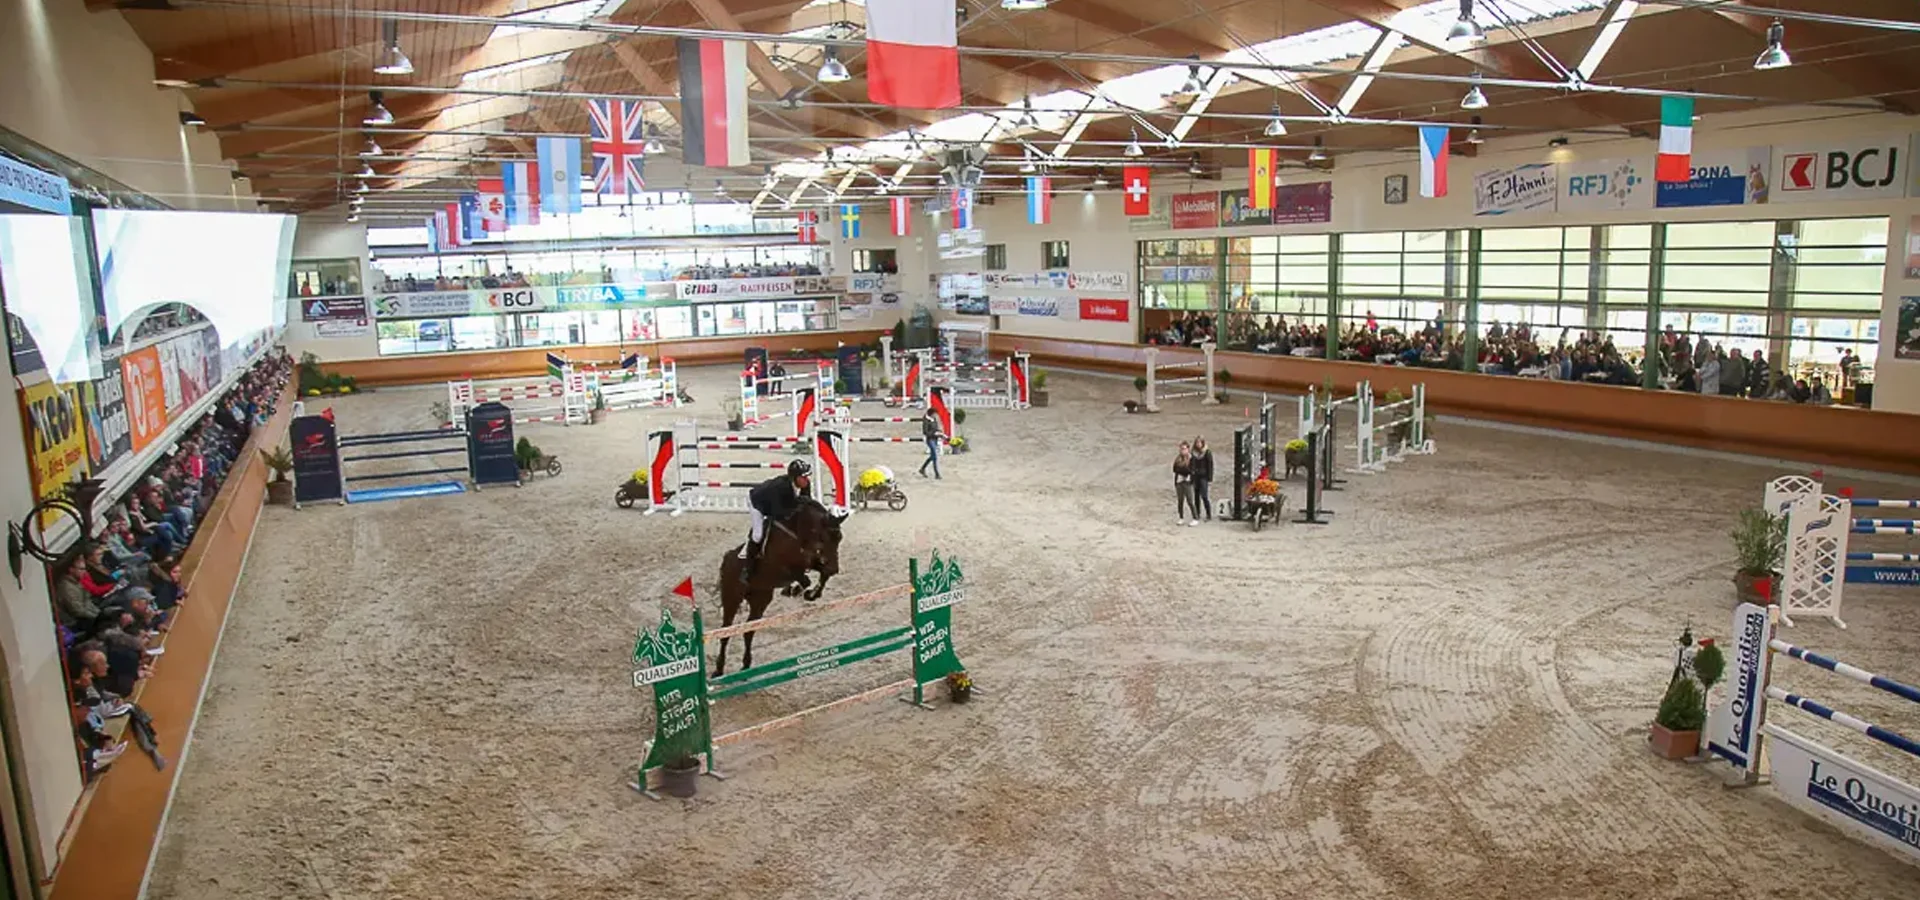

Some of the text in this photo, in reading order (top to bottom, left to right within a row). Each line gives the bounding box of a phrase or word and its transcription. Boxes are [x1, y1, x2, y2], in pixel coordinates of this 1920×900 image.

[1825, 147, 1898, 189] BCJ
[1569, 175, 1608, 197] RFJ
[562, 286, 618, 302] TRYBA
[740, 283, 791, 292] RAIFFEISEN
[504, 292, 533, 306] BCJ
[918, 590, 963, 610] QUALISPAN
[919, 620, 936, 636] WIR
[919, 626, 948, 651] STEHEN
[635, 659, 698, 684] QUALISPAN
[1727, 613, 1755, 748] Le Quotidien
[660, 688, 682, 707] WIR
[661, 695, 699, 724] STEHEN
[1809, 760, 1837, 791] Le
[1845, 778, 1920, 832] Quoti
